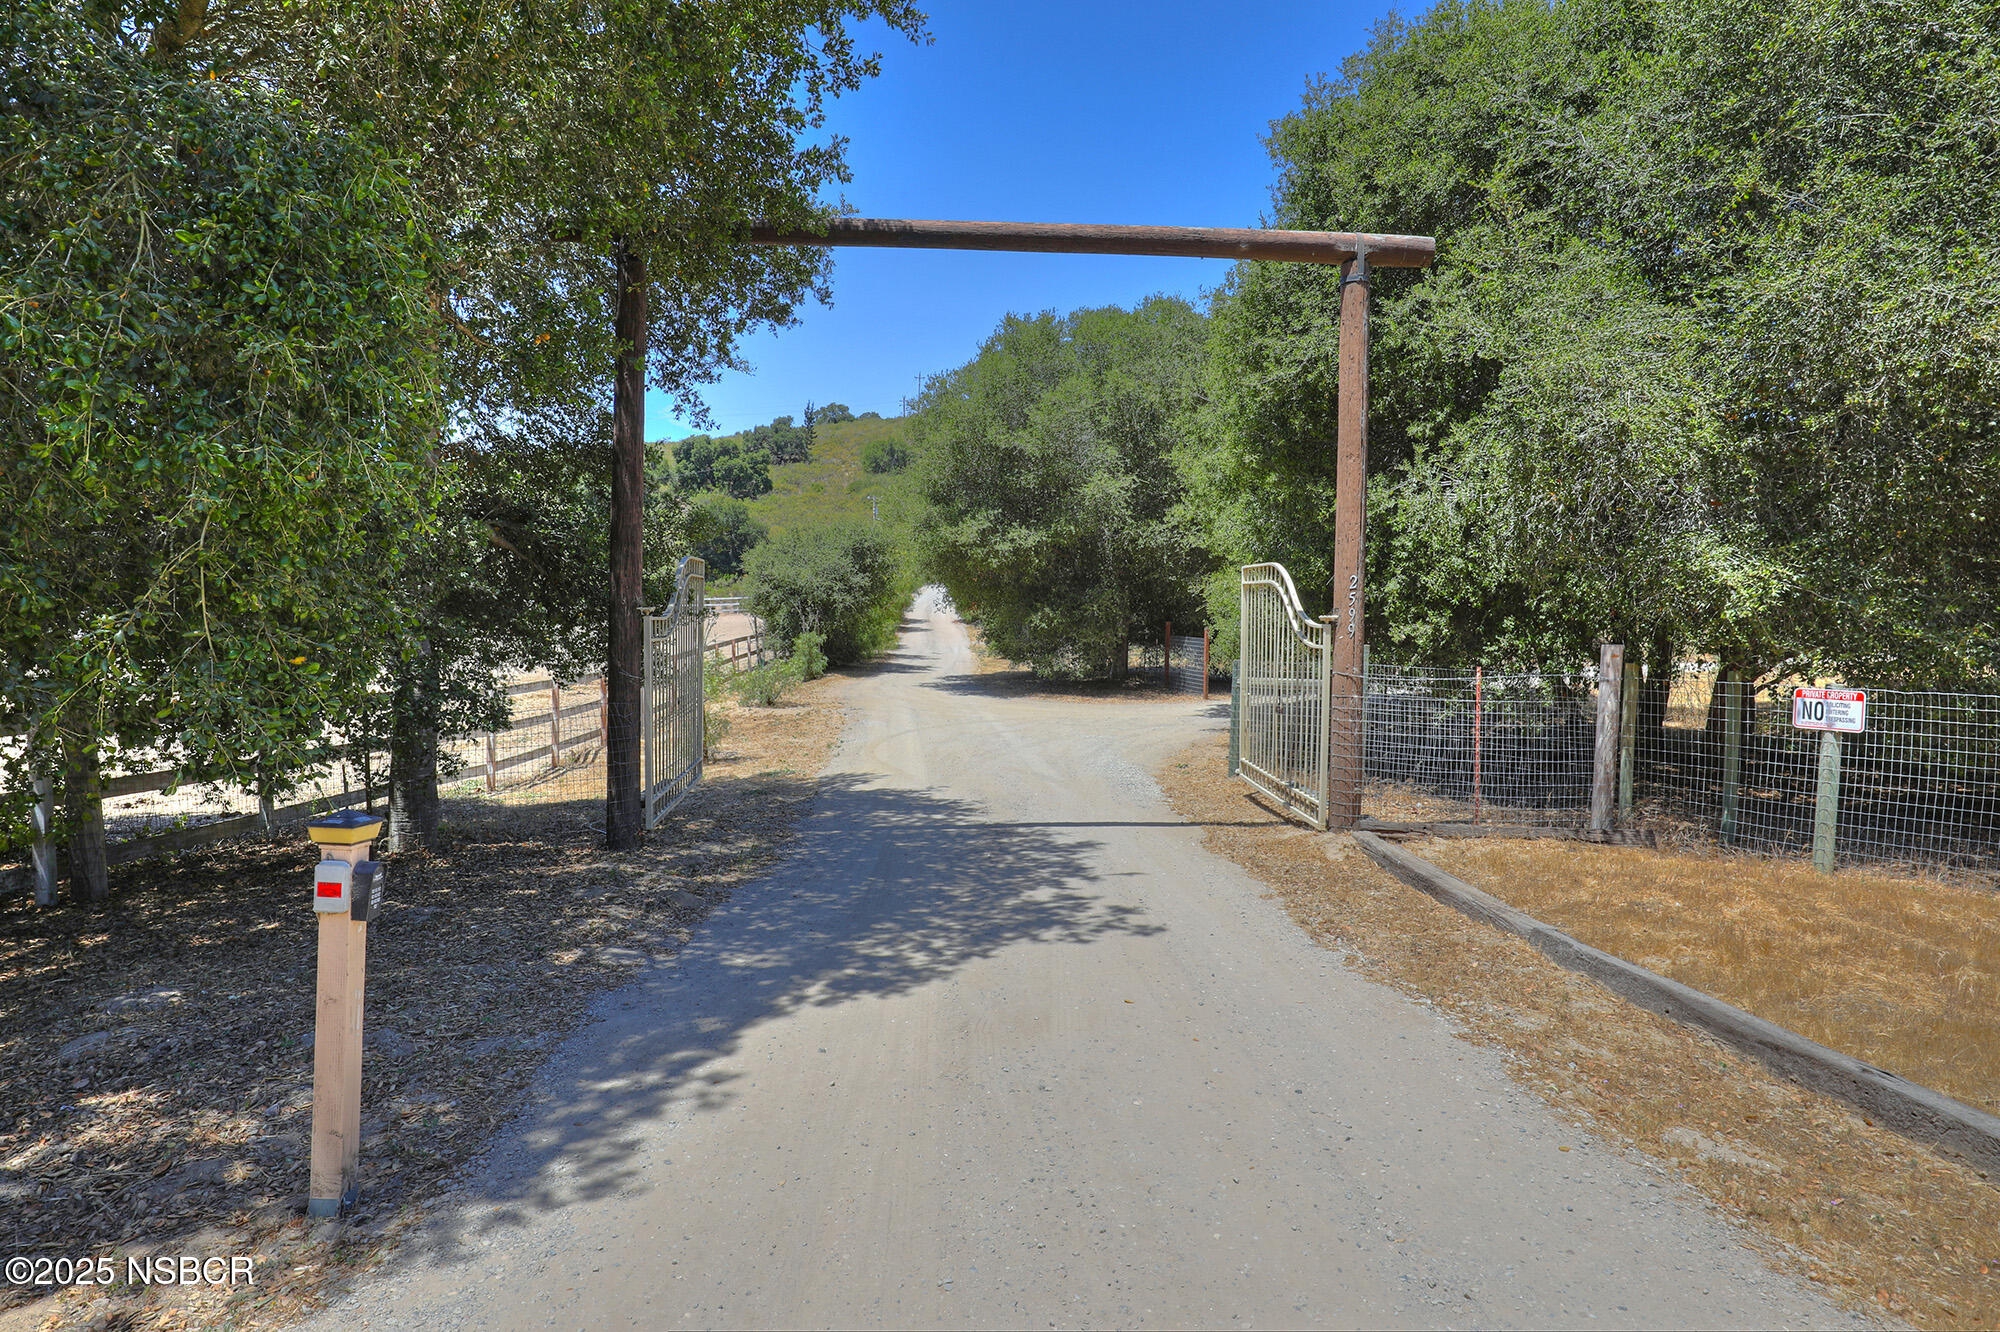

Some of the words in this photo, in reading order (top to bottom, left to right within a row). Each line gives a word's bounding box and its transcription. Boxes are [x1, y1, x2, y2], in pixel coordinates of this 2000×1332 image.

[1348, 575, 1358, 639] 2599
[1802, 690, 1826, 699] PRIVATE
[1802, 701, 1824, 721] NO
